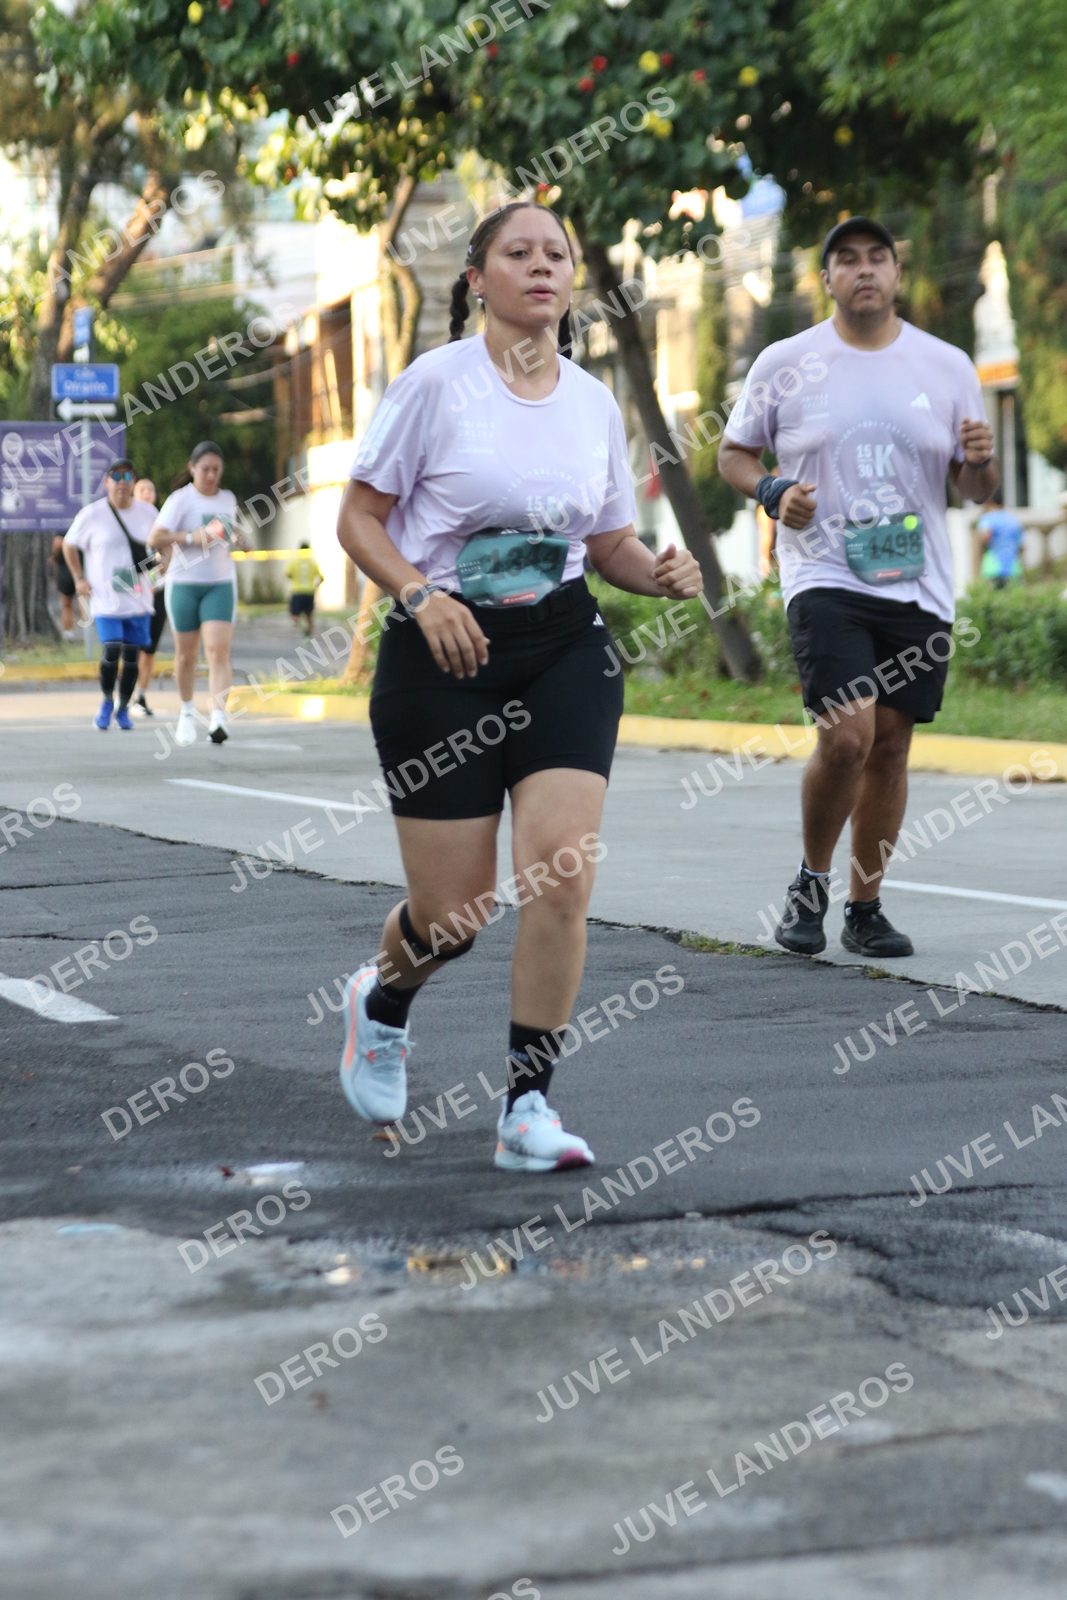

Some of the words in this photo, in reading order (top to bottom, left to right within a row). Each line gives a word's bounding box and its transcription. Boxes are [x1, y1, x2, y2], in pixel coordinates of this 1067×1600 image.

[856, 443, 872, 458] 15
[874, 443, 897, 478] K
[525, 495, 542, 511] 15
